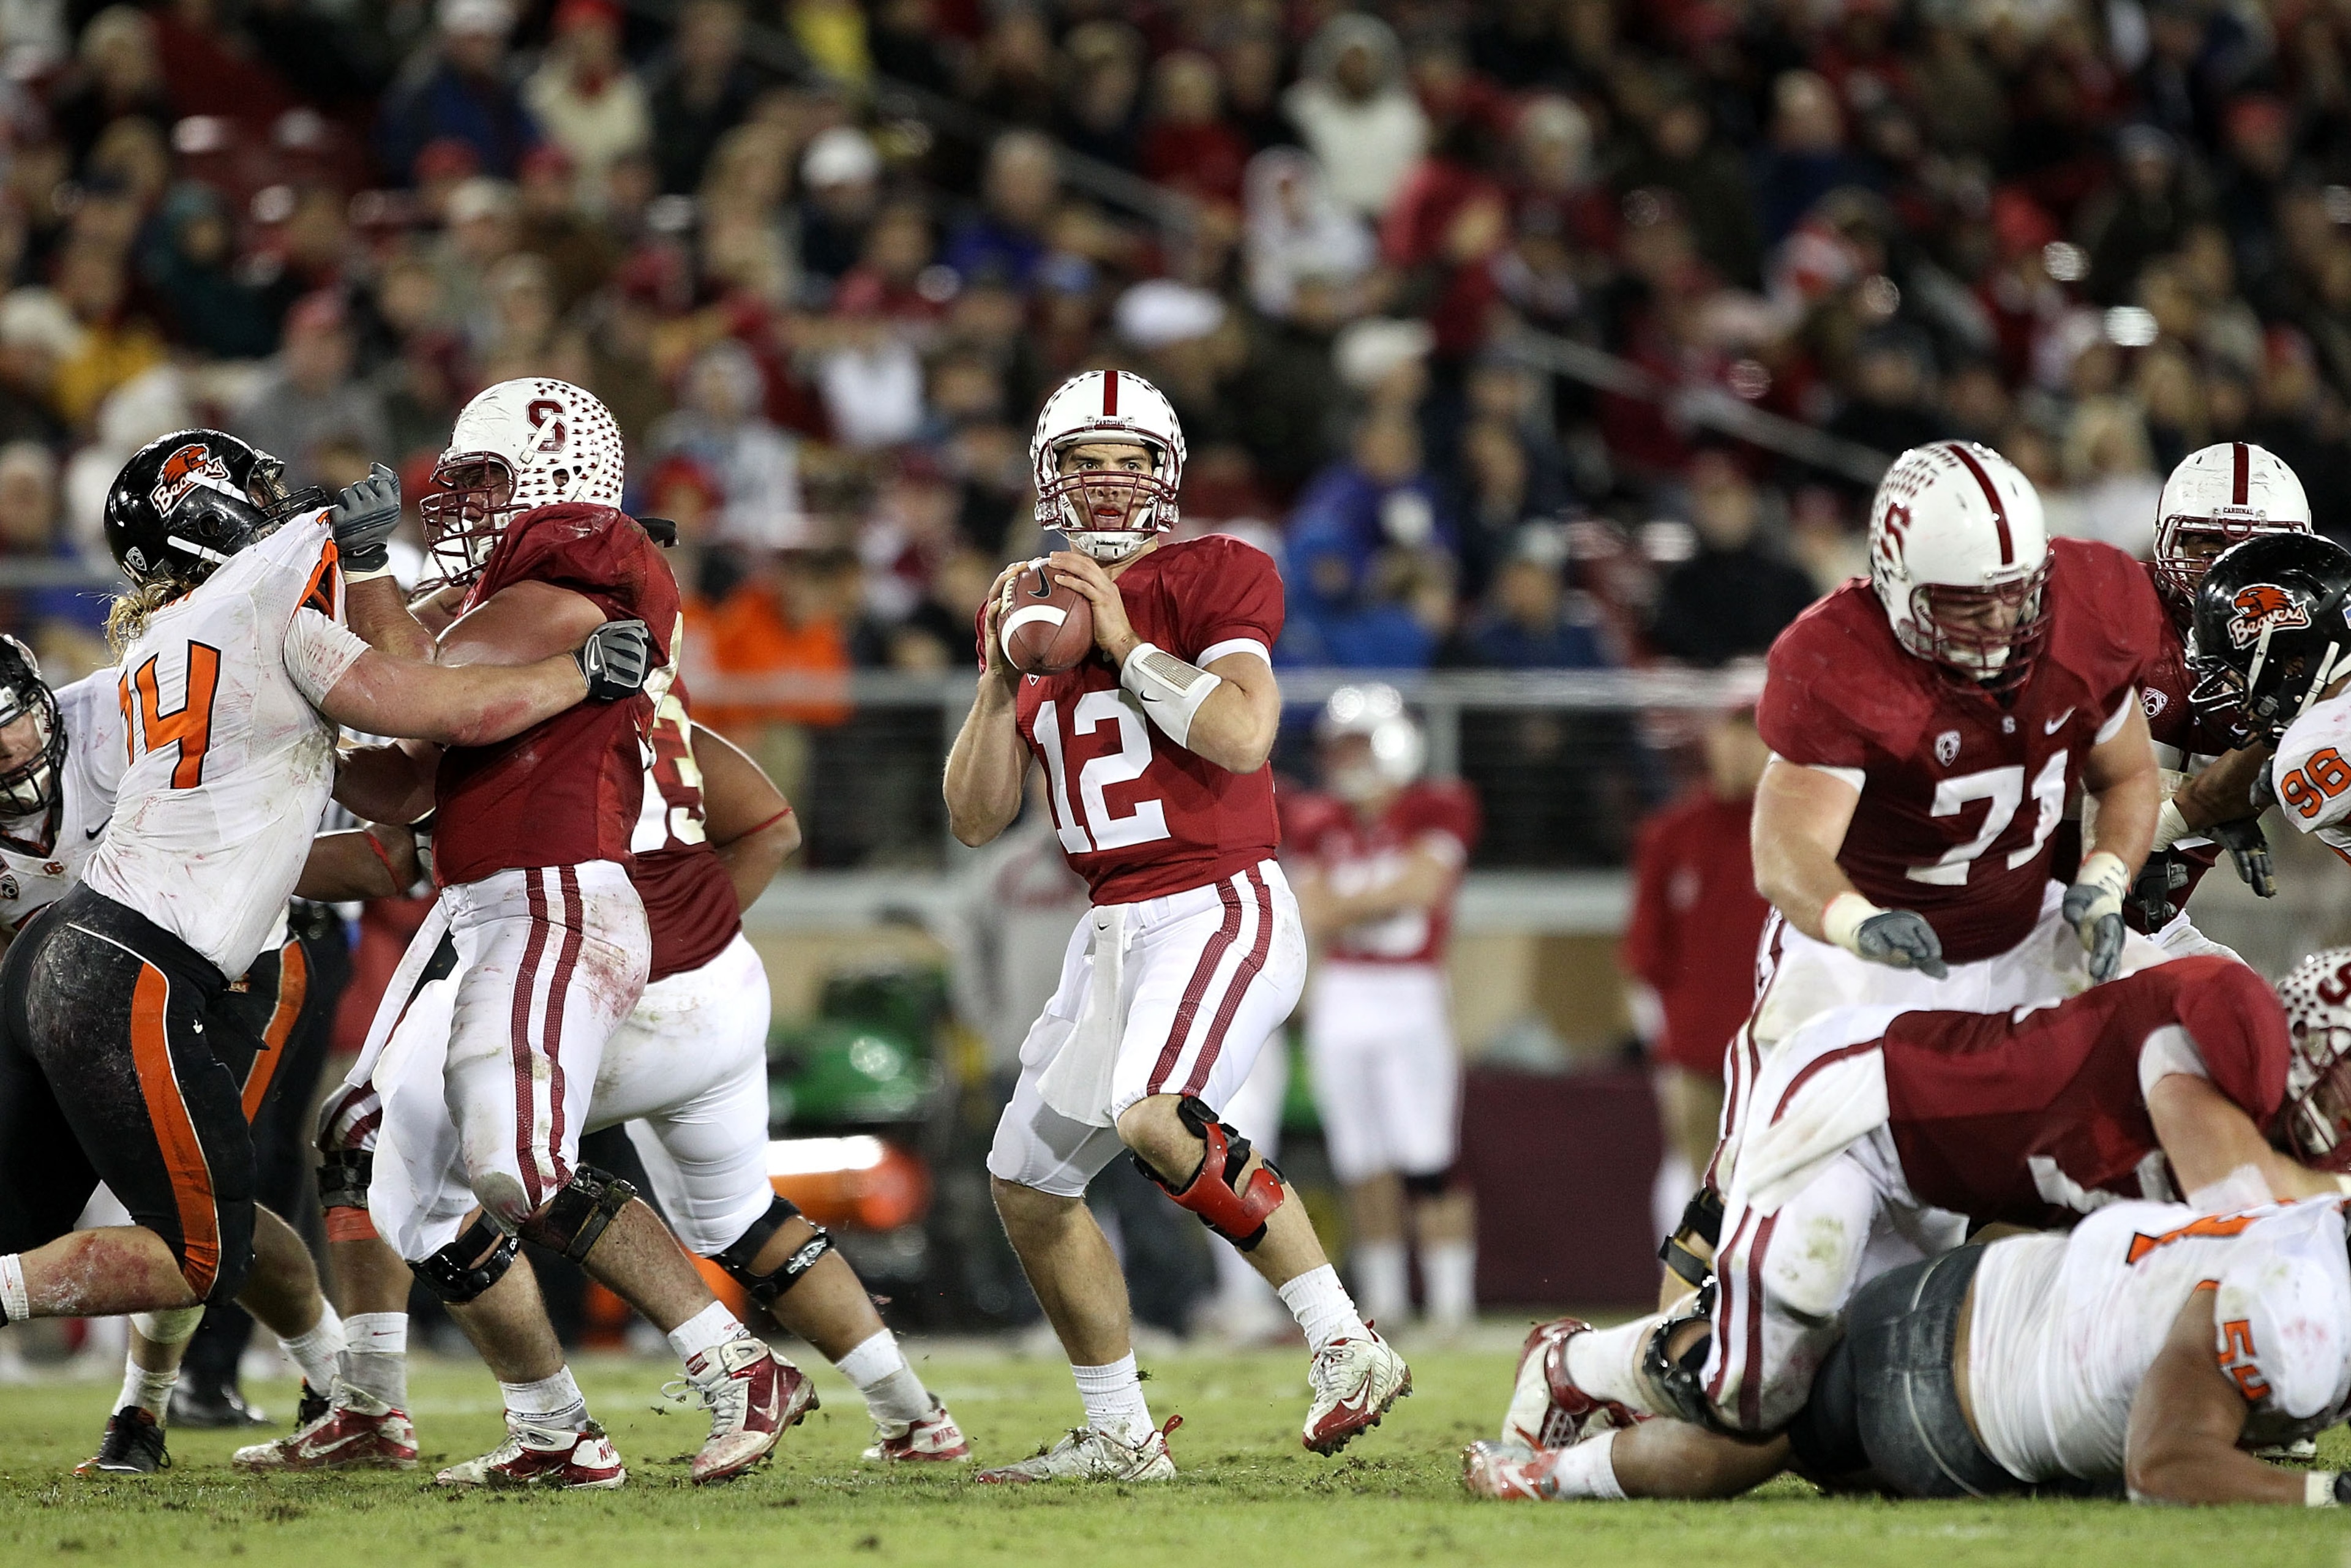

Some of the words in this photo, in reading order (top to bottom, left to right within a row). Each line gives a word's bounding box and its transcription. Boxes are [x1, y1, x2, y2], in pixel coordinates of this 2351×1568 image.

[526, 399, 568, 454] S
[154, 461, 225, 512] Beaers
[2230, 605, 2306, 645] Beavers
[1033, 688, 1171, 854] 12
[2281, 747, 2351, 819] 96
[1905, 748, 2068, 885] 71
